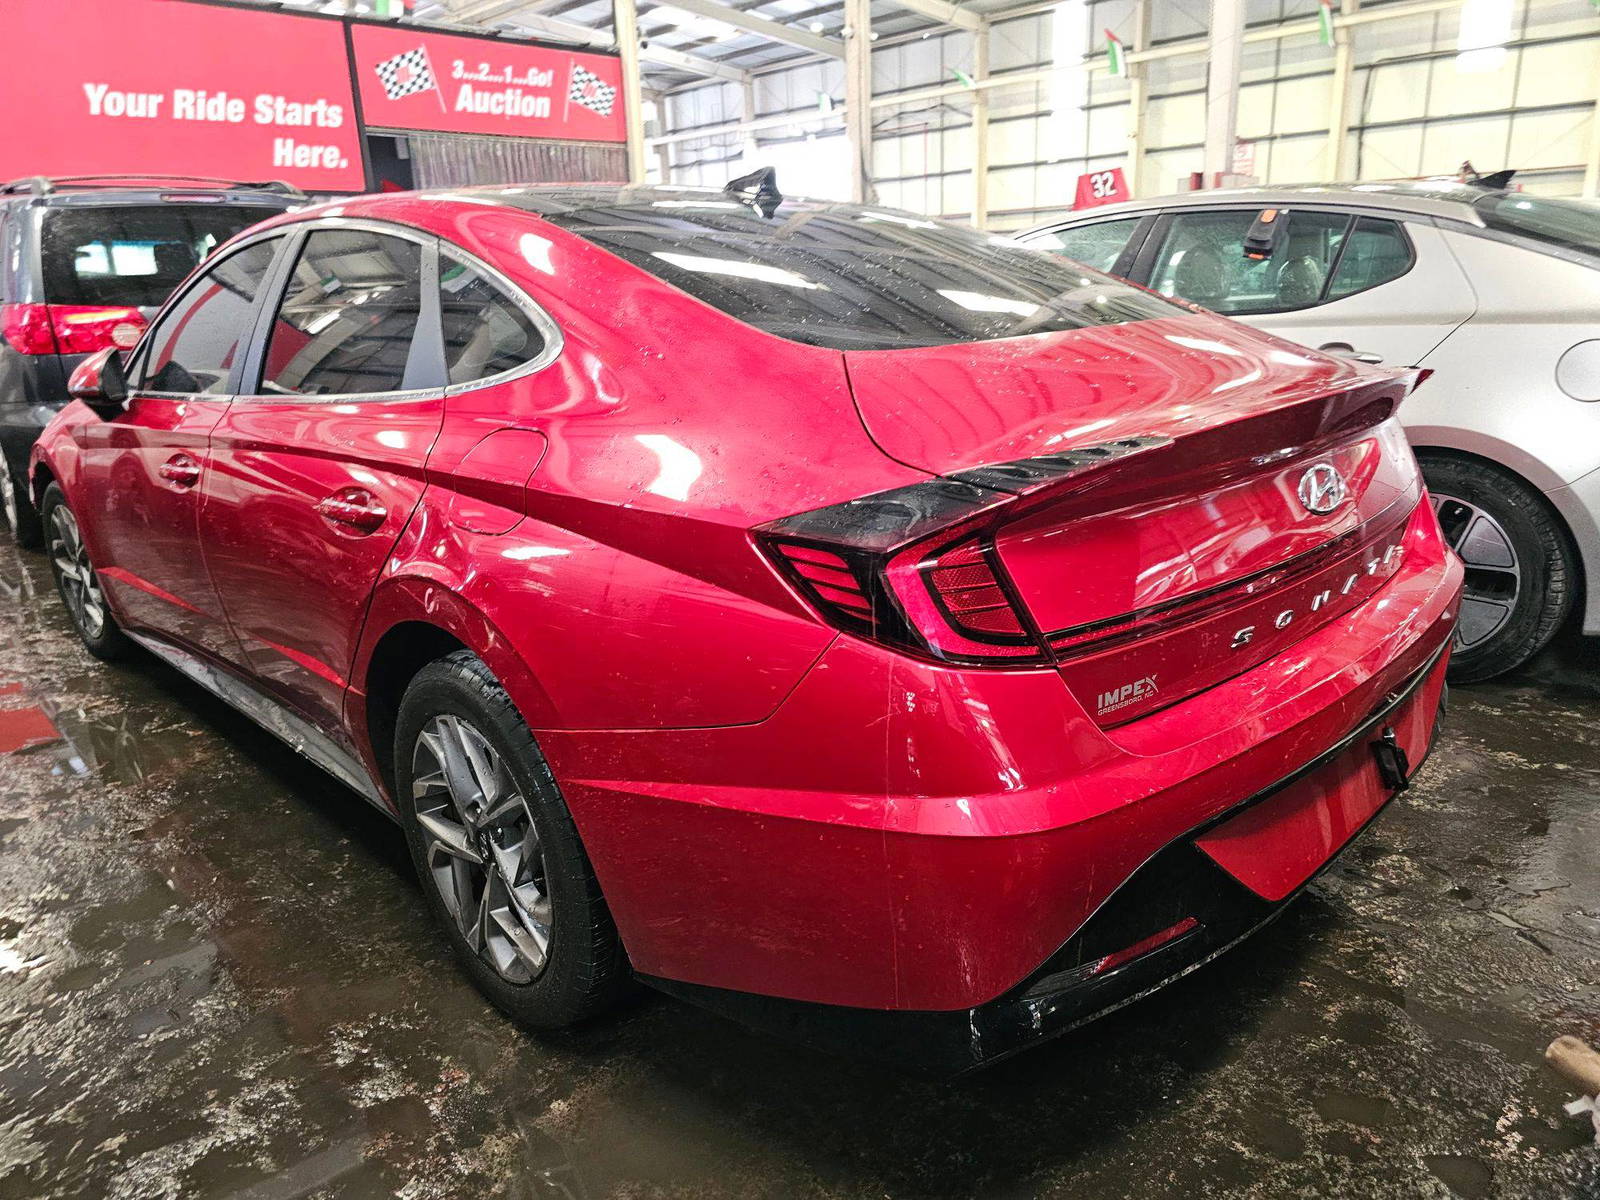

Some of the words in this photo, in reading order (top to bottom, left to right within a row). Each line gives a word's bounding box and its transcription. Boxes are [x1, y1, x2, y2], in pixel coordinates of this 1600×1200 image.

[83, 83, 164, 118] Your
[172, 89, 246, 123] Ride
[253, 94, 344, 128] Starts
[454, 83, 551, 118] Auction
[272, 137, 349, 169] Here.
[1090, 171, 1118, 199] 32
[1097, 672, 1159, 709] IMPEX
